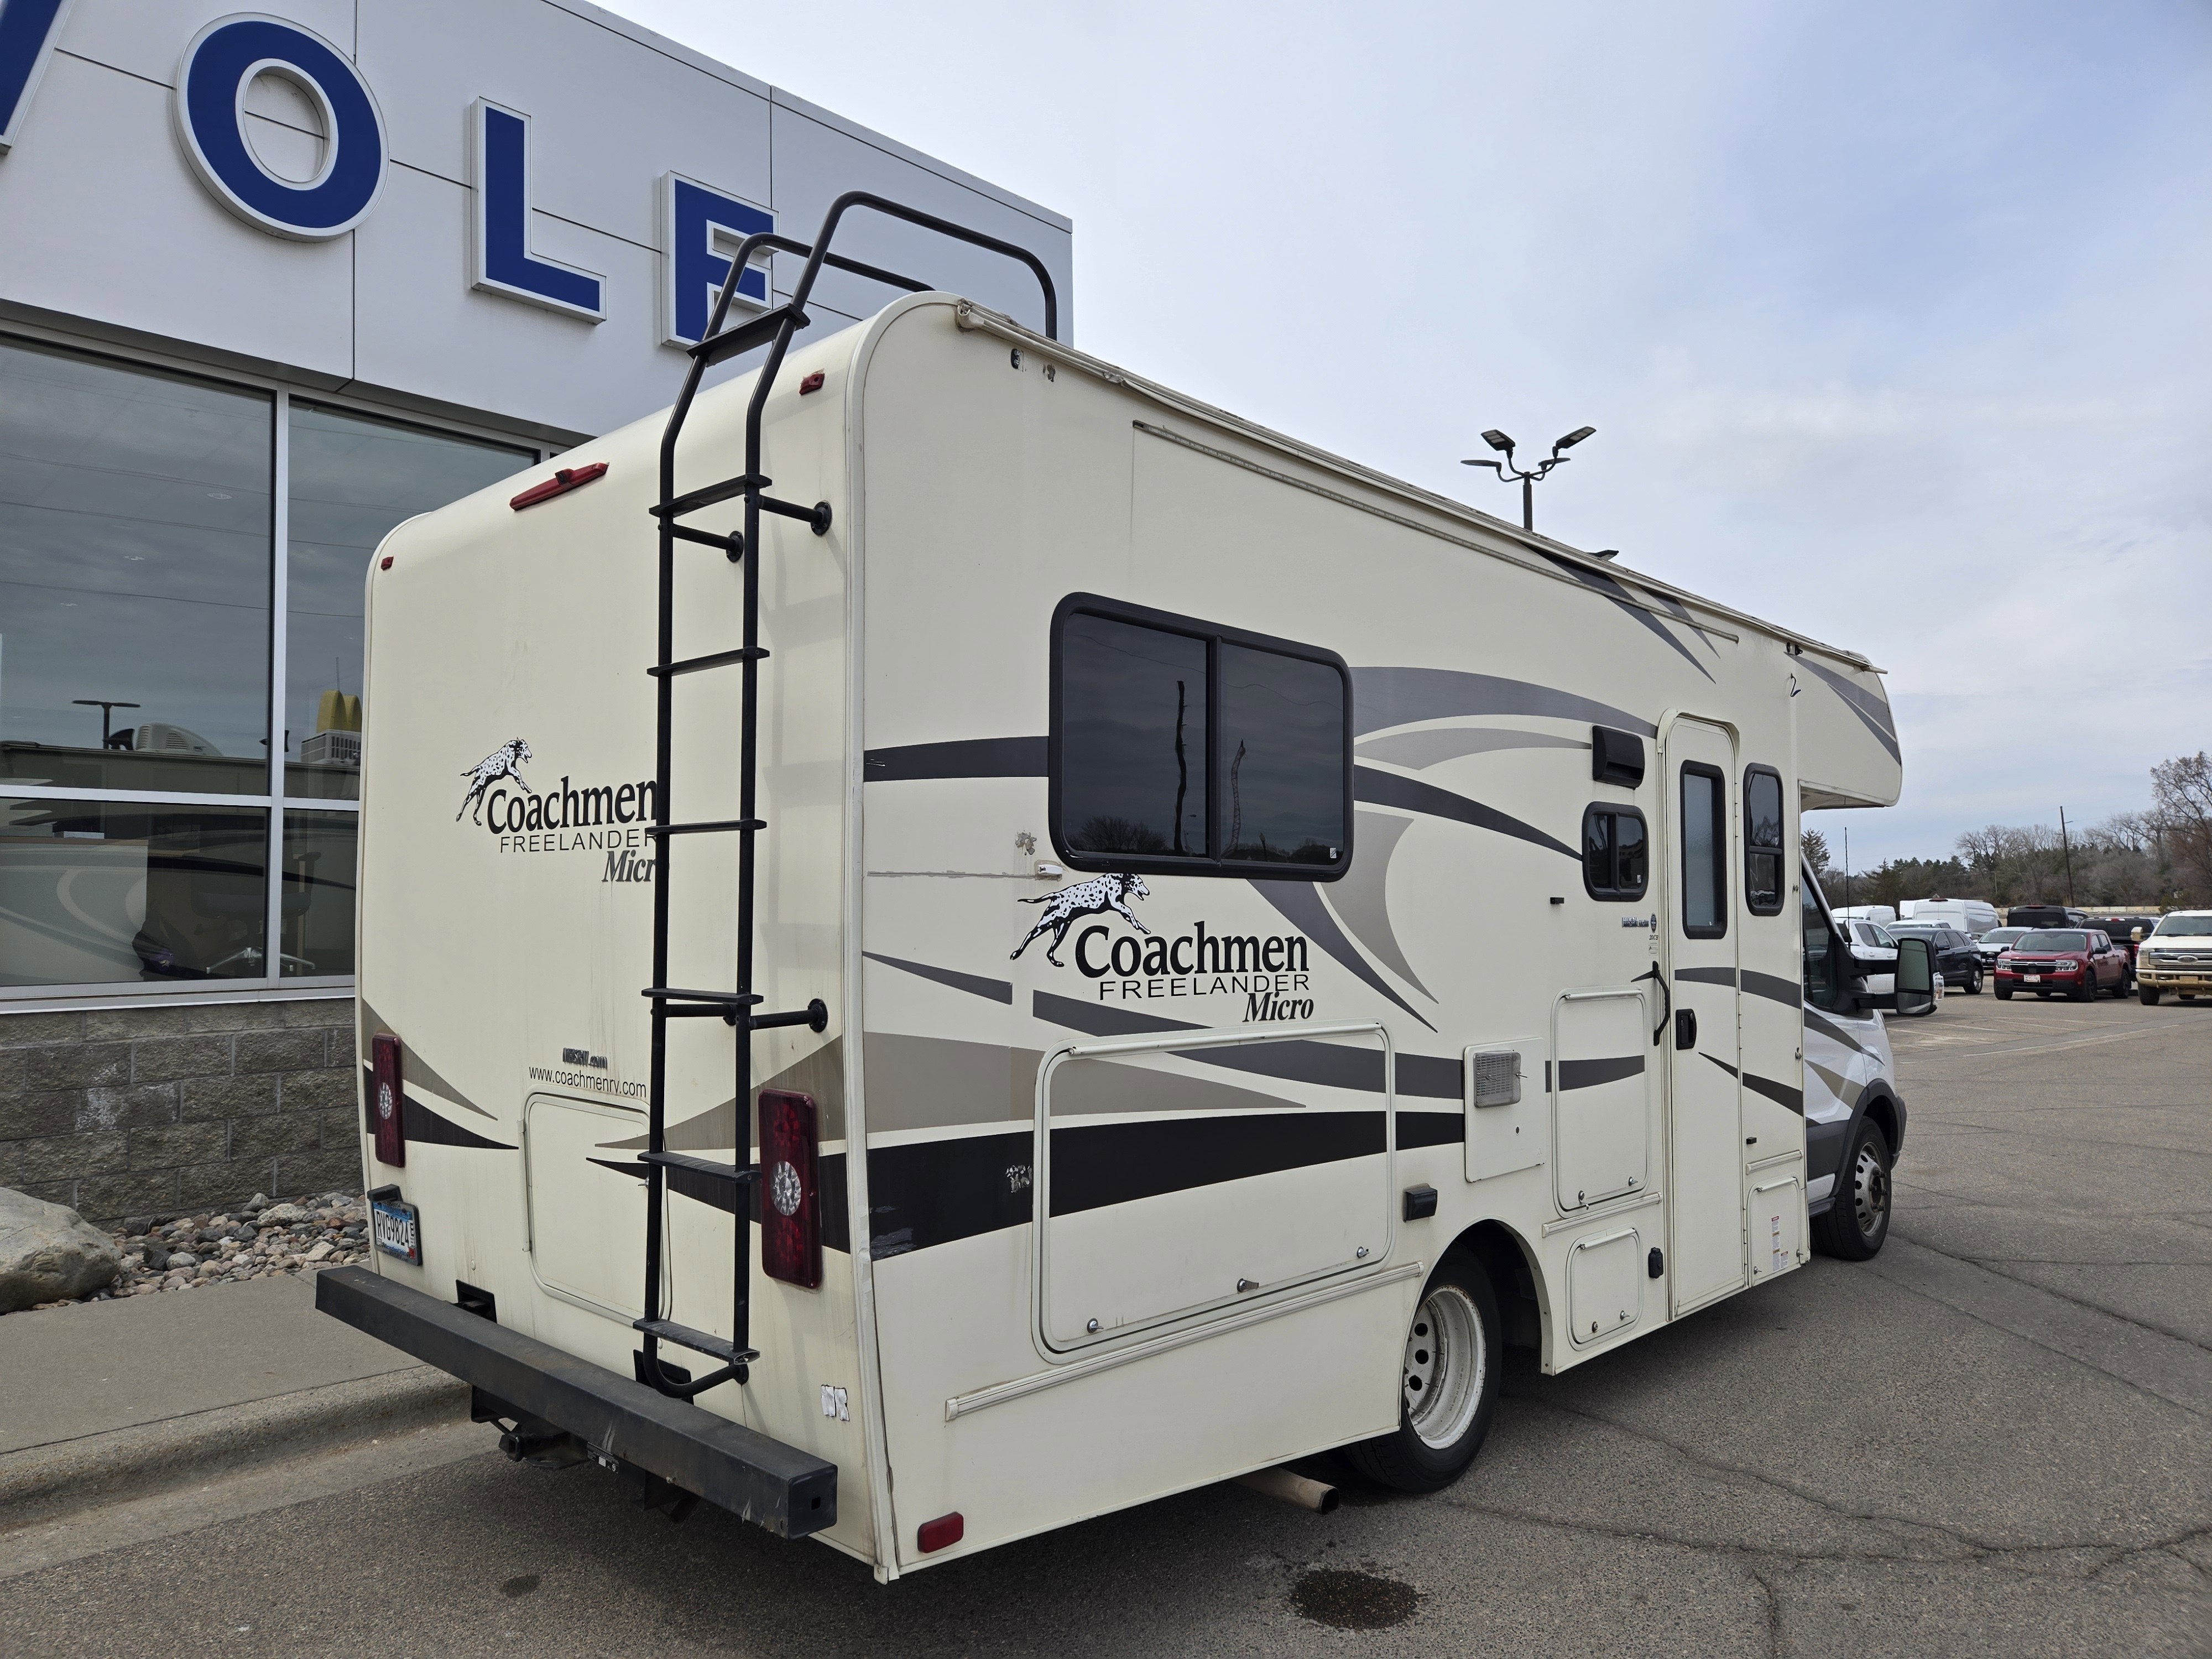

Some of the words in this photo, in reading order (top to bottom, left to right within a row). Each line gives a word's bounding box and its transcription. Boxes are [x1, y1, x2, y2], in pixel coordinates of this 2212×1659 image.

[0, 0, 779, 352] OLF
[487, 775, 657, 834] Coachmen
[602, 849, 657, 883] Micr
[1075, 920, 1310, 978] Coachmen
[1099, 974, 1310, 1000] FREELANDER
[1242, 992, 1314, 1022] Micro
[529, 1066, 646, 1098] www.coachmenrv.com
[376, 1211, 409, 1248] RVG9824
